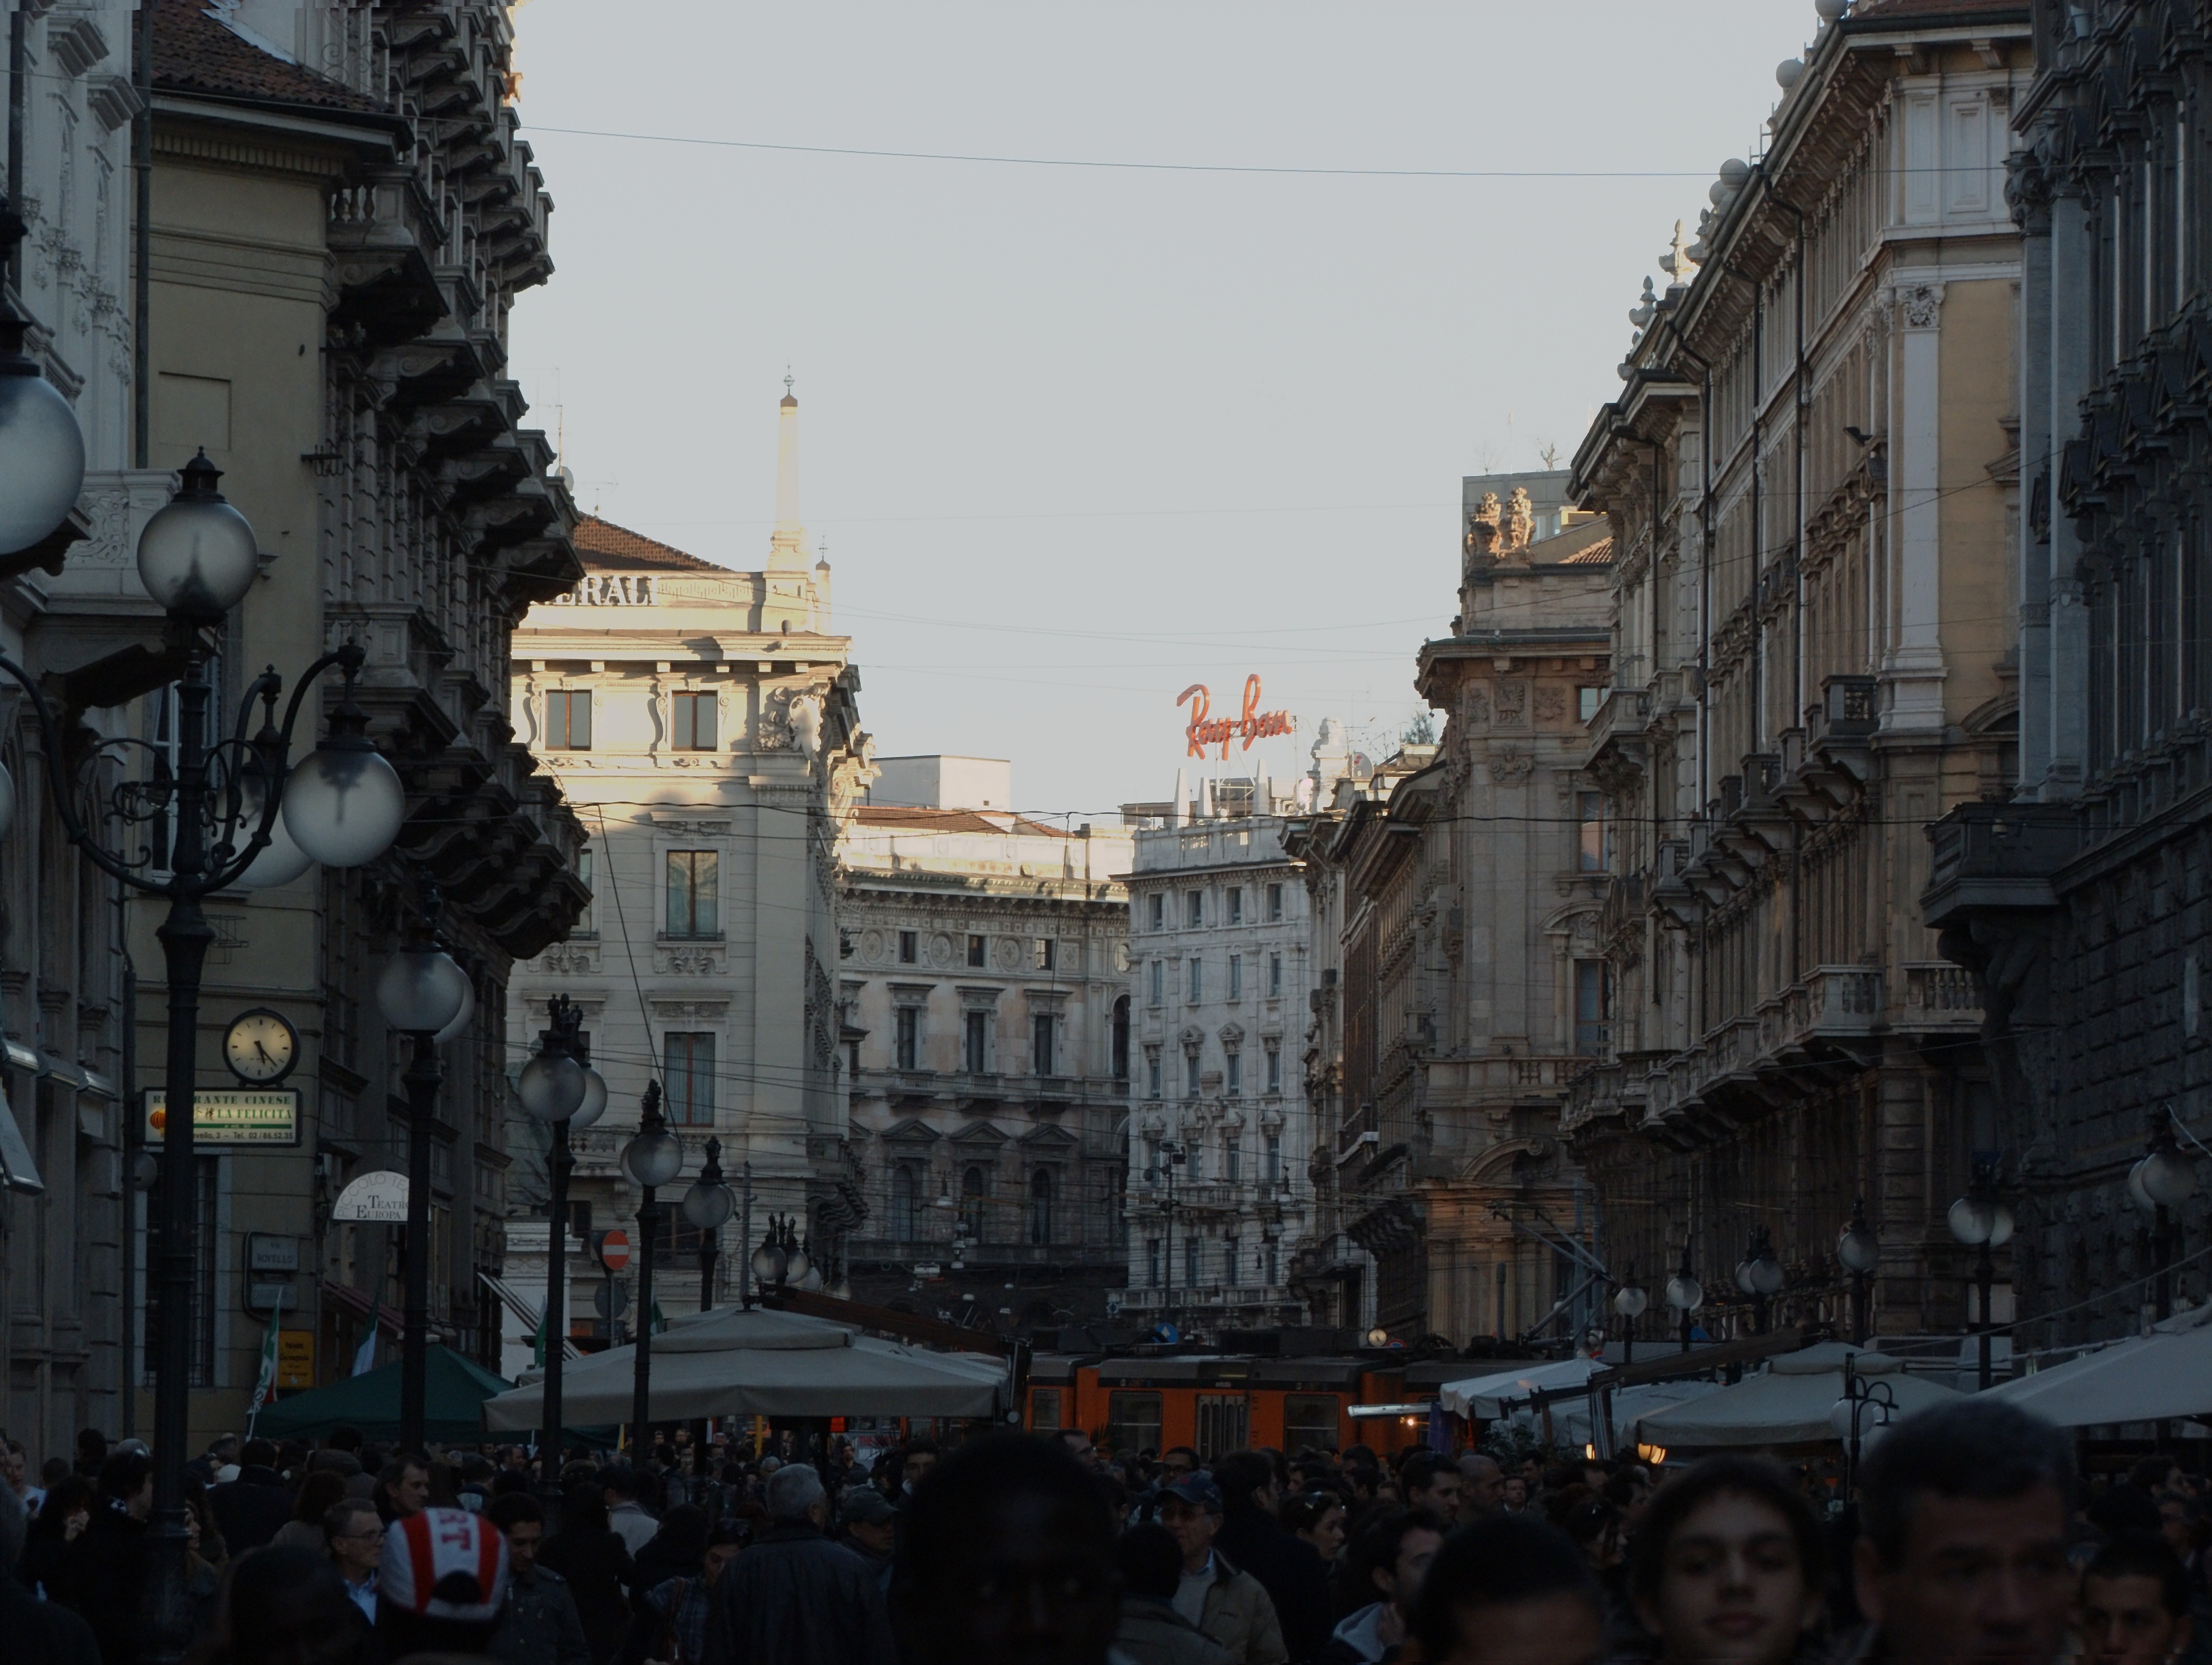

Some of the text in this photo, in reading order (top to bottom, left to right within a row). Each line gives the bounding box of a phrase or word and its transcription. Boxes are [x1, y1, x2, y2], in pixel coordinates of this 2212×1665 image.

[245, 1096, 291, 1105] CINESE
[217, 1109, 232, 1119] LA
[336, 1173, 386, 1218] PICCOLO
[257, 1254, 293, 1264] ROVELLO
